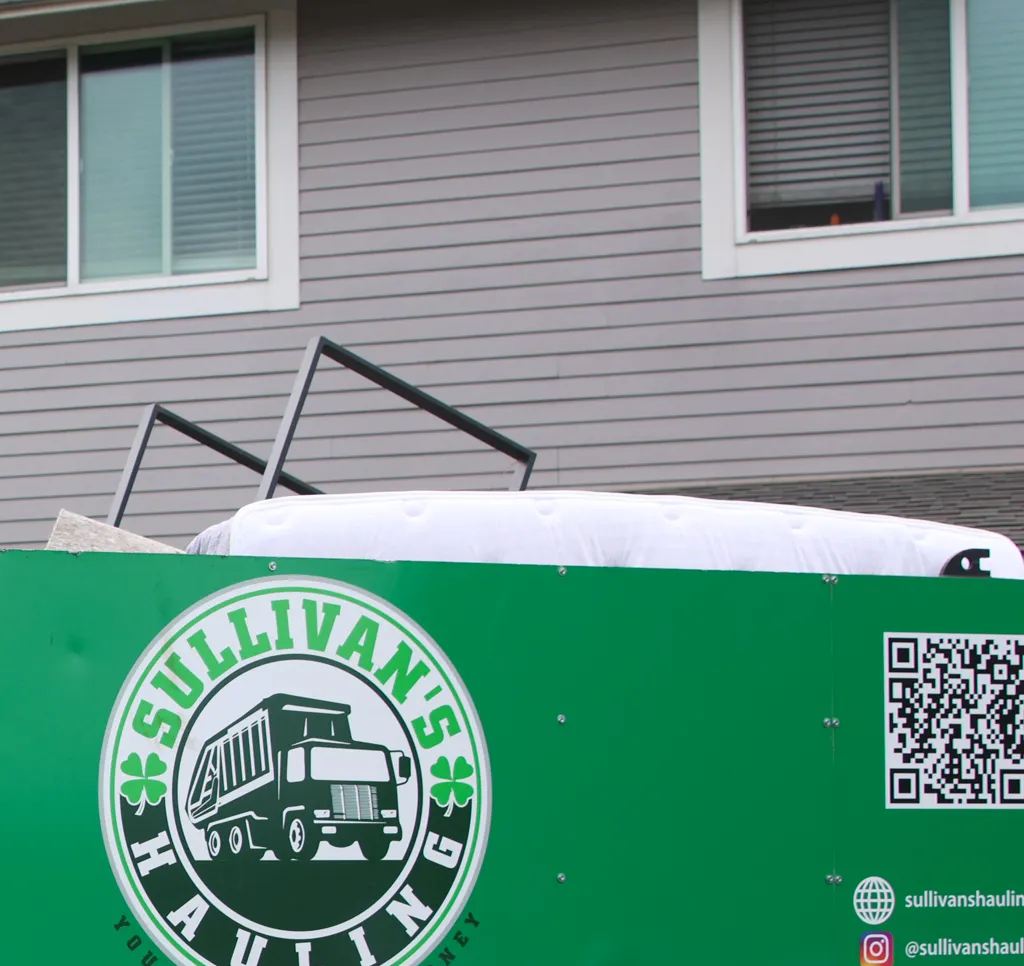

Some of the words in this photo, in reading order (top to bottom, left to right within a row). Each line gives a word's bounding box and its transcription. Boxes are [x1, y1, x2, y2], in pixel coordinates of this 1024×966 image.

[133, 599, 460, 749] SULLIVAN'S
[905, 890, 1024, 908] sullivanshaulin
[905, 938, 1024, 958] @sullivanshaul
